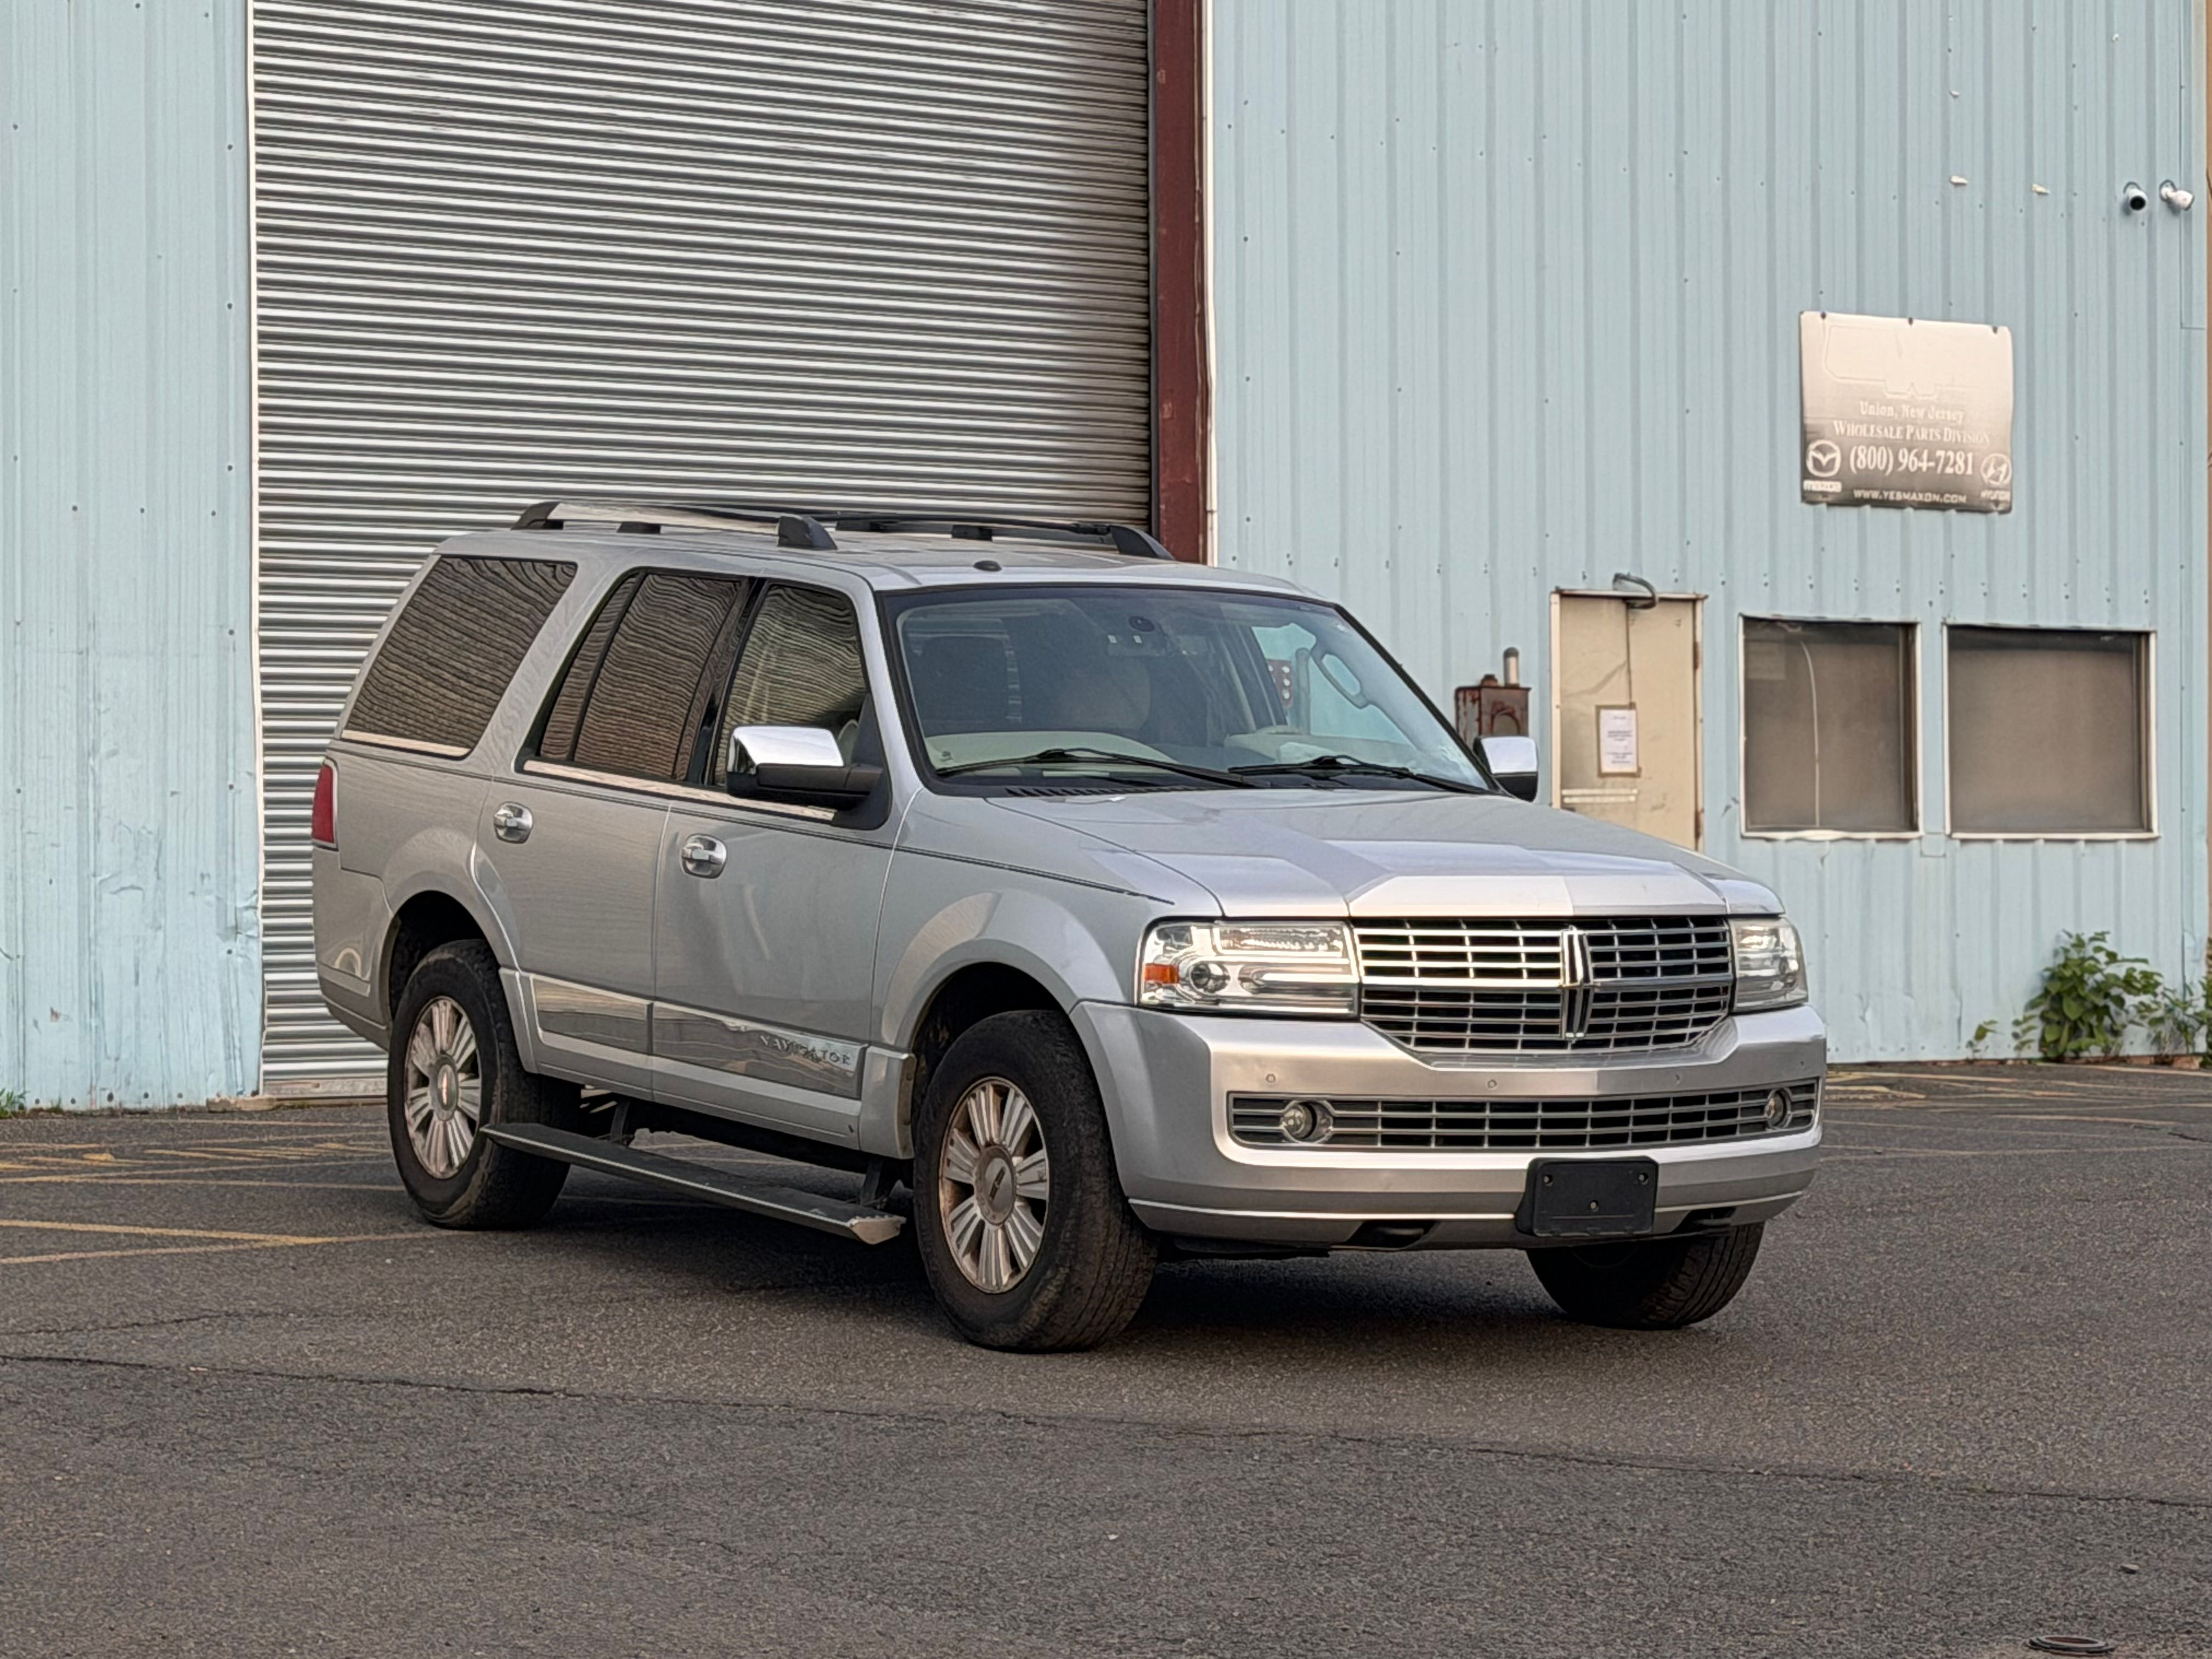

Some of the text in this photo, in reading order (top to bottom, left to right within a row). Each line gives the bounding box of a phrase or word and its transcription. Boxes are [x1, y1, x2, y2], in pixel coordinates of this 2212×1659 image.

[1859, 400, 1965, 425] Union, New Jersey
[1833, 421, 1990, 447] WHOLESALE PARTS DIVISION
[1849, 445, 1973, 476] (800) 964-7281
